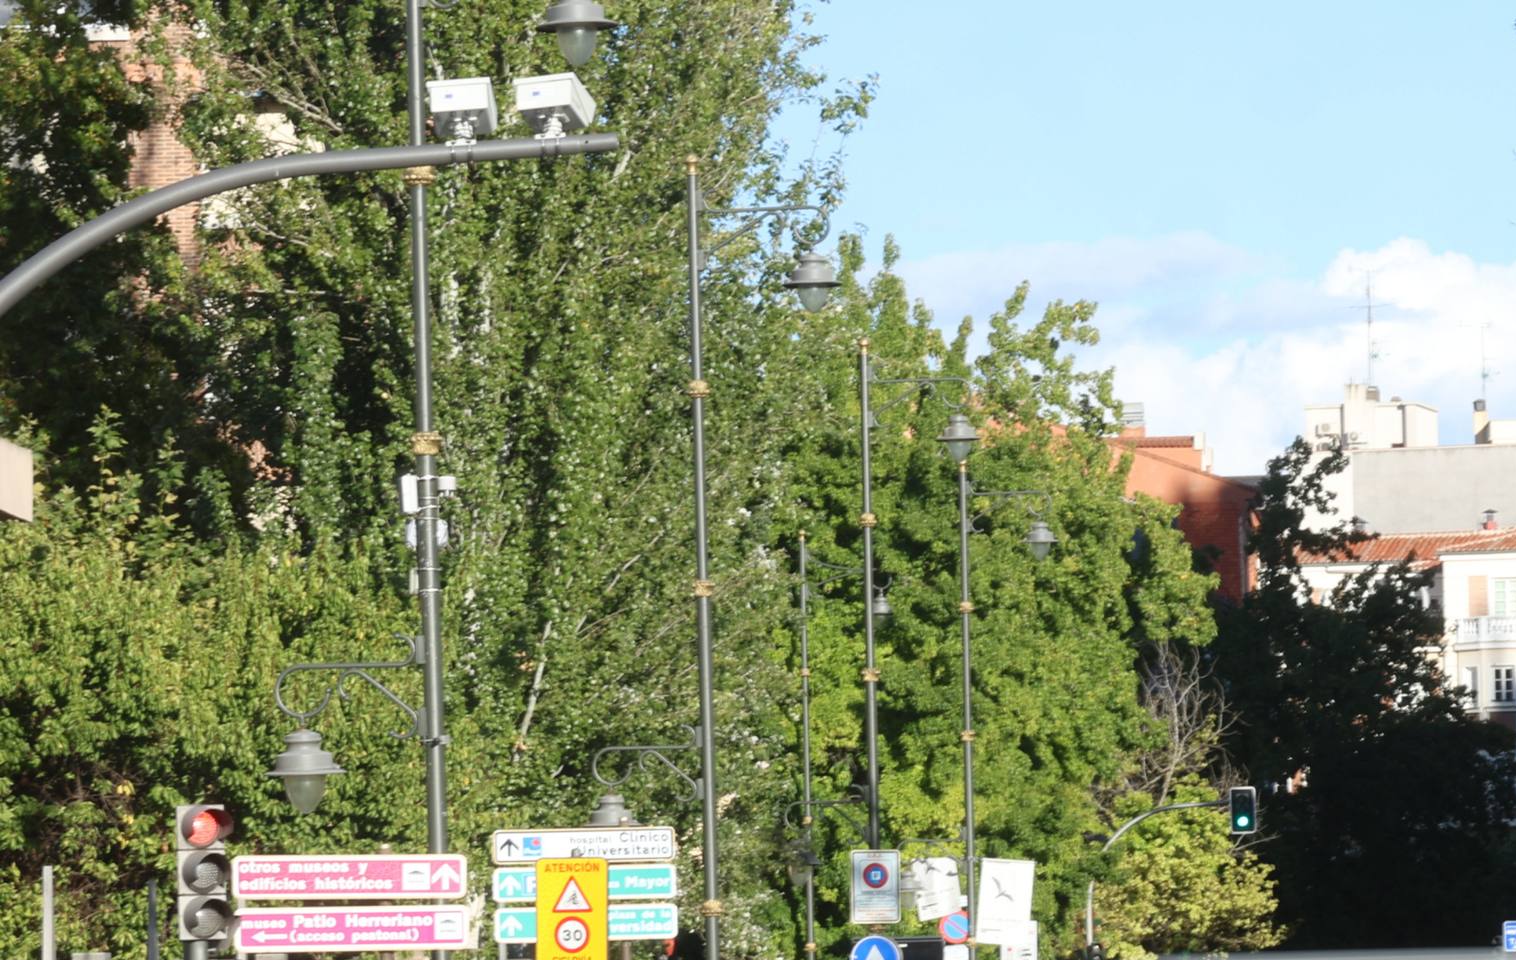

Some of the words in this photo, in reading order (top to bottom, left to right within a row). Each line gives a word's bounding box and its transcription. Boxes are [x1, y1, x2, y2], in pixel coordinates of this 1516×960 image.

[569, 835, 612, 847] hospital
[239, 862, 281, 874] otros
[288, 861, 349, 874] museos
[357, 861, 368, 875] y
[544, 861, 600, 873] ATENCIÓN
[239, 877, 307, 891] edificios
[314, 876, 393, 890] históricos
[624, 875, 671, 890] Mayor
[241, 918, 287, 929] museo
[292, 914, 337, 928] Patio
[345, 913, 433, 928] Herreriano
[289, 929, 345, 944] (acceso
[562, 929, 583, 942] 30
